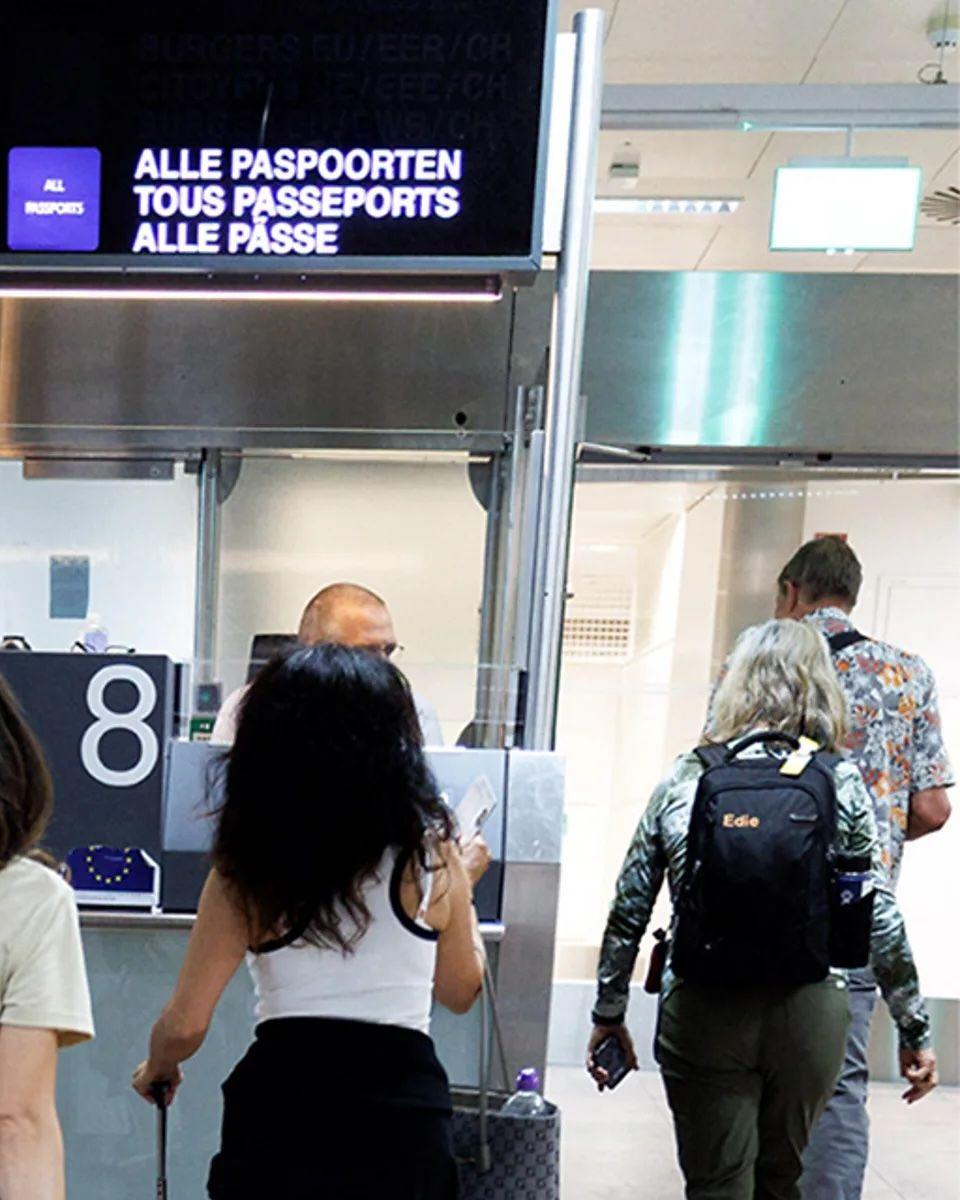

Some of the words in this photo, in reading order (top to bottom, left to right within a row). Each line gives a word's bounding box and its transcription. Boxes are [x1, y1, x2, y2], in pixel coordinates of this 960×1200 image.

[134, 149, 223, 180] ALLE
[231, 149, 461, 181] PASPOORTEN
[43, 179, 66, 193] ALL
[133, 186, 225, 217] TOUS
[234, 186, 459, 219] PASSEPORTS
[133, 223, 221, 253] ALLE
[80, 664, 160, 788] 8
[722, 813, 760, 828] Edie
